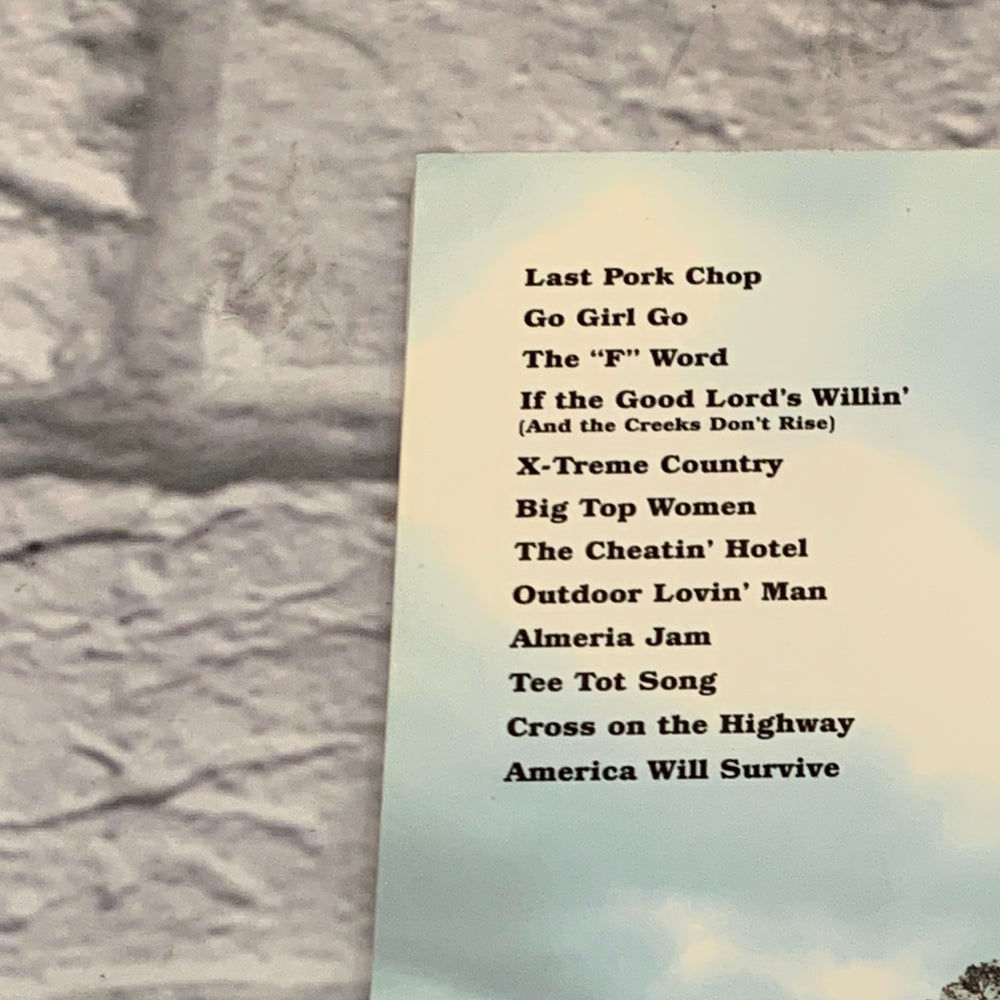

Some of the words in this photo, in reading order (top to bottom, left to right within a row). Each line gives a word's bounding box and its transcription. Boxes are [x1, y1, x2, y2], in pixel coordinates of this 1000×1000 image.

[524, 268, 592, 286] Last
[603, 267, 674, 286] Pork
[685, 266, 762, 289] Chop
[524, 309, 565, 327] Go
[576, 308, 636, 327] Girl
[647, 308, 688, 326] Go
[522, 350, 580, 368] The
[650, 348, 729, 367] Word
[520, 391, 546, 409] If
[555, 390, 603, 409] the
[615, 389, 695, 408] Good
[519, 419, 571, 436] (And
[580, 419, 616, 433] the
[624, 418, 701, 432] Creeks
[779, 416, 835, 433] Rise)
[516, 456, 649, 476] X-Treme
[660, 455, 784, 477] Country
[515, 499, 568, 523] Big
[579, 498, 637, 522] Top
[646, 497, 757, 517] Women
[514, 542, 573, 560] The
[725, 539, 808, 558] Hotel
[513, 584, 642, 604] Outdoor
[761, 582, 828, 601] Man
[509, 628, 634, 648] Almeria
[645, 627, 712, 646] Jam
[509, 673, 563, 692] Tee
[574, 672, 627, 691] Tot
[639, 671, 718, 695] Song
[507, 717, 595, 737] Cross
[607, 719, 646, 736] on
[657, 715, 708, 735] the
[719, 713, 855, 740] Highway
[503, 761, 637, 782] America
[648, 760, 709, 779] Will
[720, 758, 840, 779] Survive
